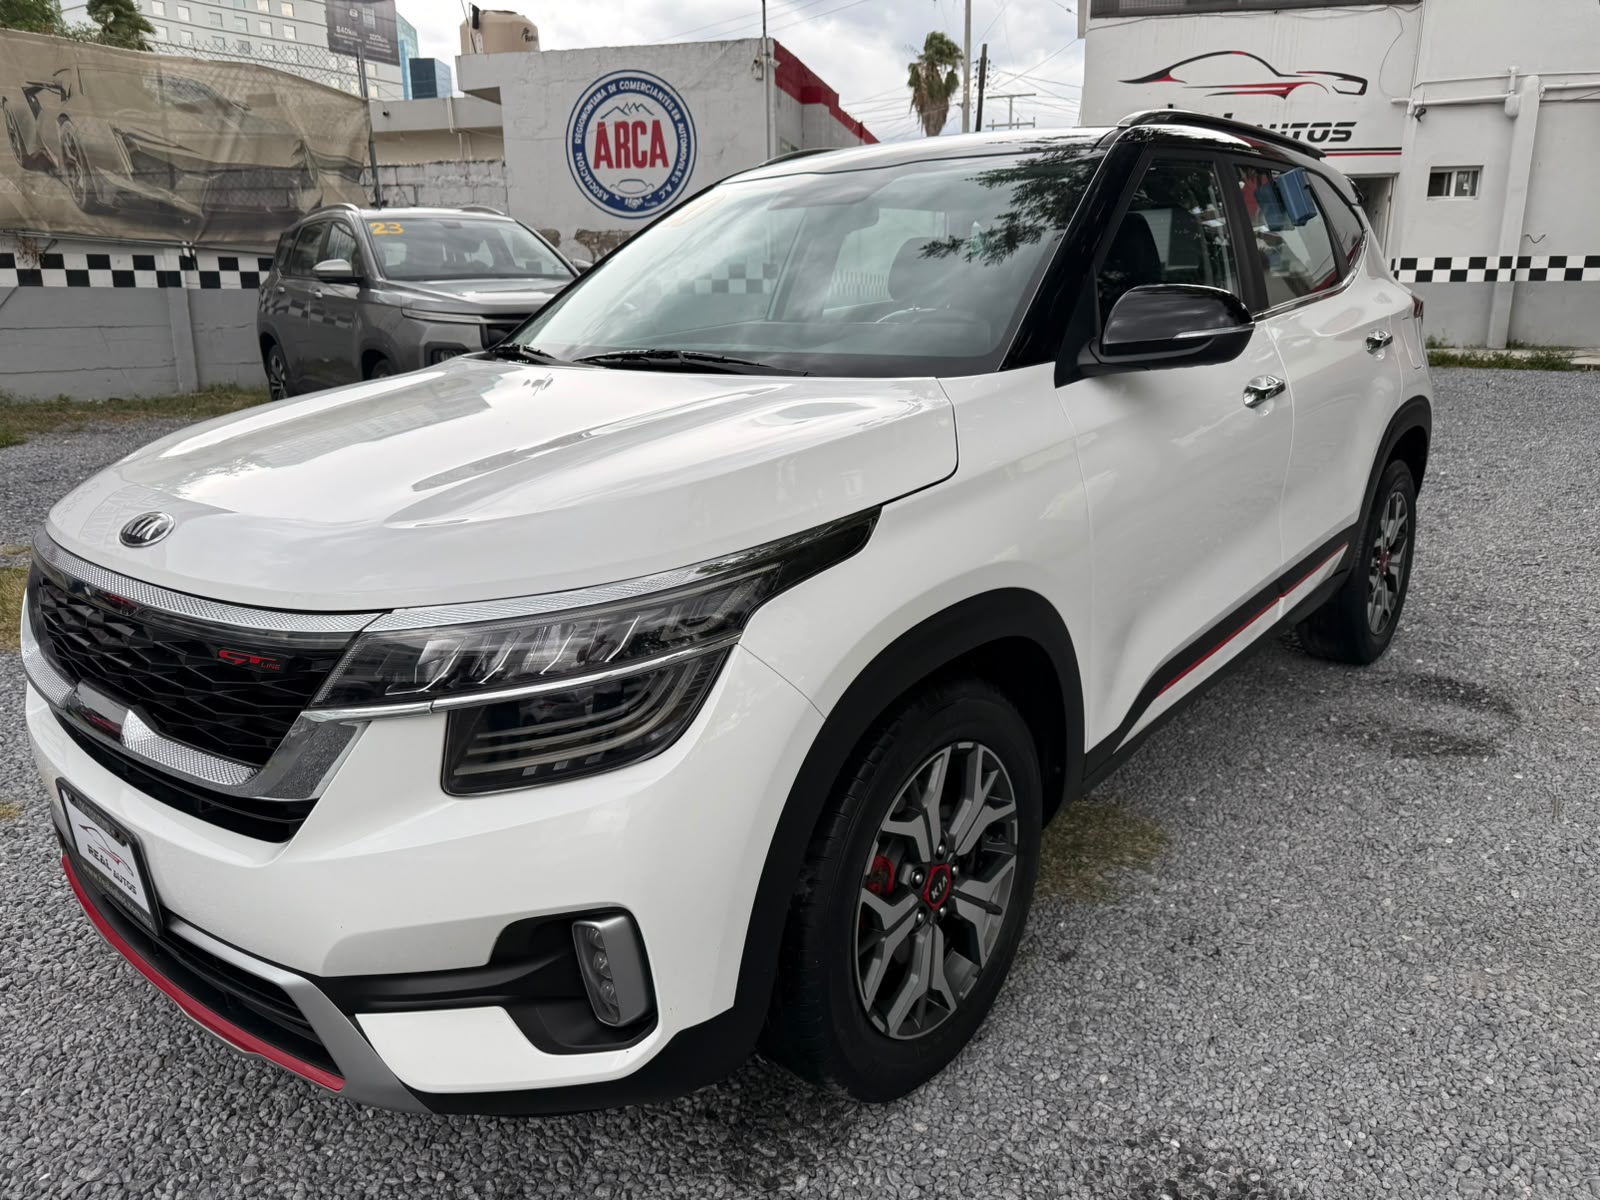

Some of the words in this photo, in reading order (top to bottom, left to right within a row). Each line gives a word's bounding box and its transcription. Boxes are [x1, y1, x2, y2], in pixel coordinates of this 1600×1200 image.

[607, 82, 617, 94] DE
[619, 80, 675, 111] COMERCIANTES
[574, 89, 608, 144] REGIOMONTANA
[670, 106, 682, 120] EN
[593, 119, 670, 170] ARCA
[1256, 121, 1358, 143] TOS
[671, 123, 689, 184] AUTOMOVILES
[575, 152, 609, 201] ASOCIACION
[369, 222, 405, 236] 23
[219, 649, 278, 665] GT
[87, 844, 112, 871] REAL
[112, 869, 137, 896] AUTOS
[930, 874, 948, 900] KIA
